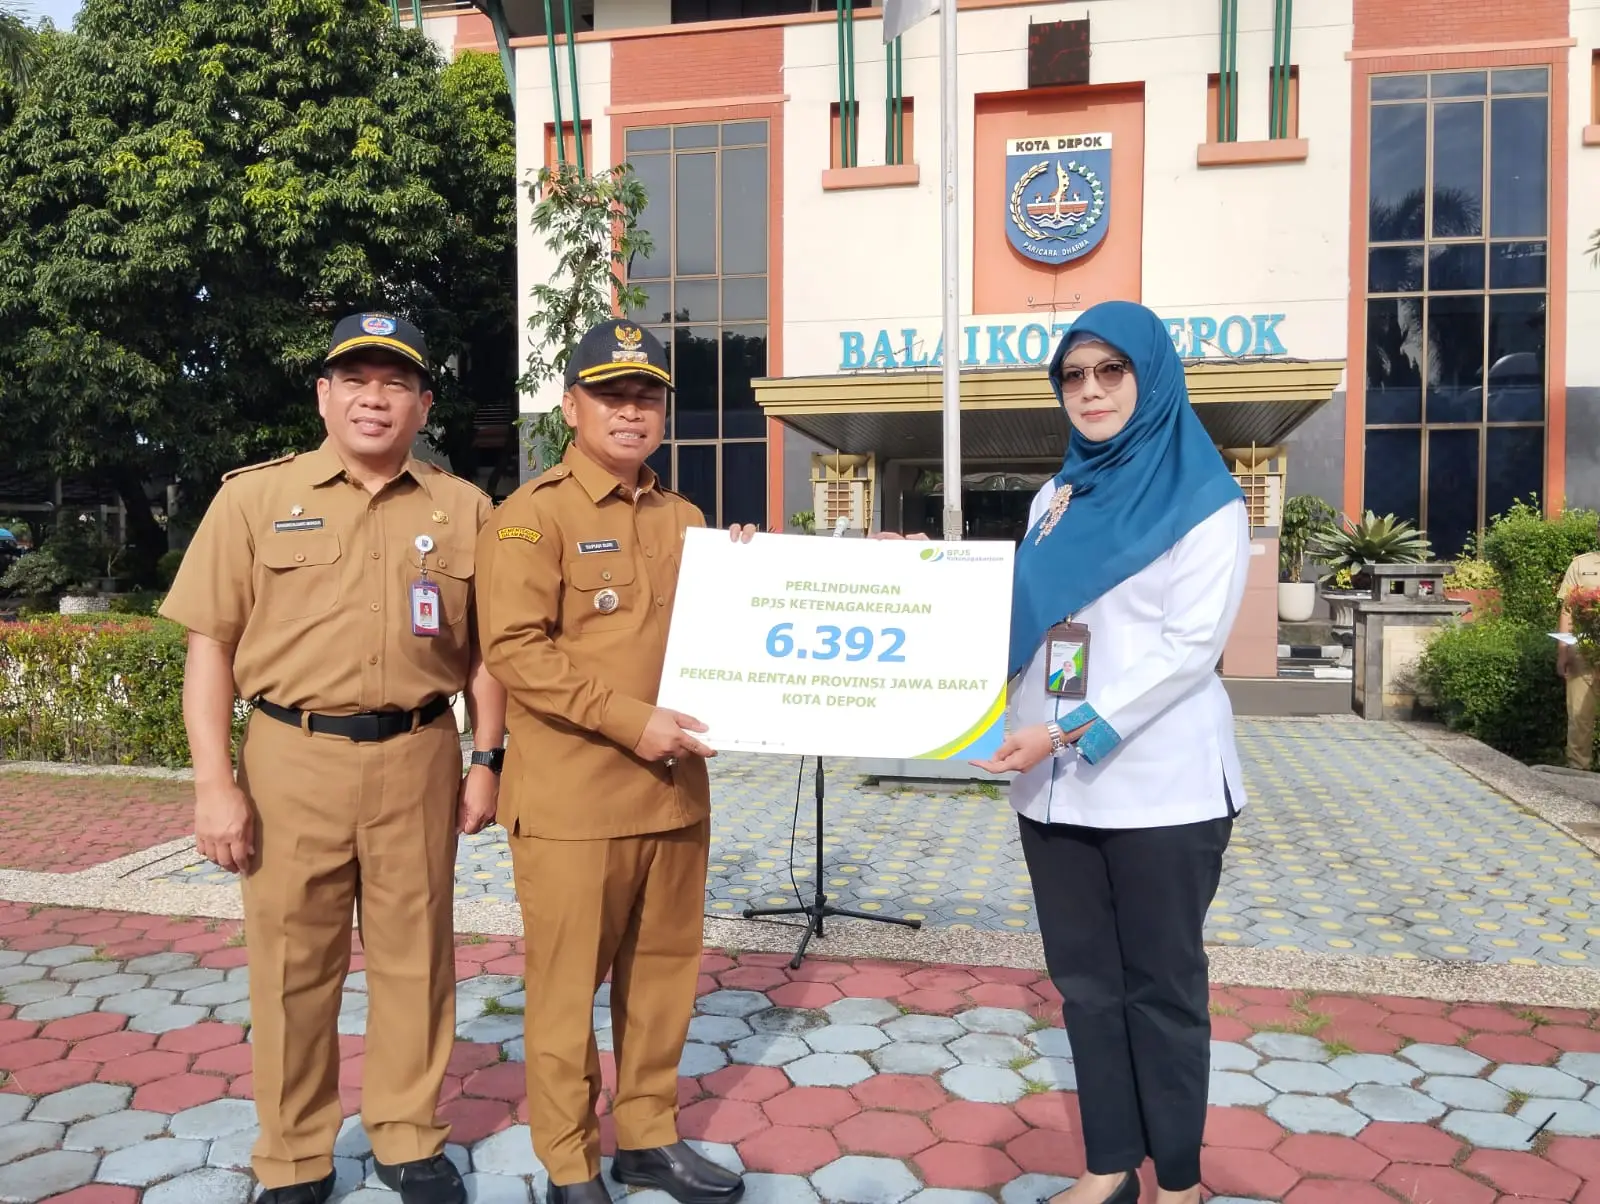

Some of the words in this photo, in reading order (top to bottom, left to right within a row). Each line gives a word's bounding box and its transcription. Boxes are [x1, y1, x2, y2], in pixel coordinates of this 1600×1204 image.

[1016, 140, 1050, 152] KOTA
[1058, 136, 1102, 149] DEPOK
[1023, 241, 1058, 256] PARICARA
[1062, 239, 1089, 256] DHARMA
[1160, 314, 1288, 359] EPOK
[785, 580, 901, 595] PERLINDUNGAN
[751, 596, 786, 610] BPJS
[789, 598, 932, 614] KETENAGAKERJAAN
[765, 622, 906, 663] 6.392
[680, 667, 743, 682] PEKERJA
[747, 671, 807, 686] RENTAN
[811, 675, 886, 689] PROVINSI
[890, 678, 933, 690] JAWA
[937, 678, 988, 691] BARAT
[782, 693, 822, 706] KOTA
[826, 695, 877, 708] DEPOK
